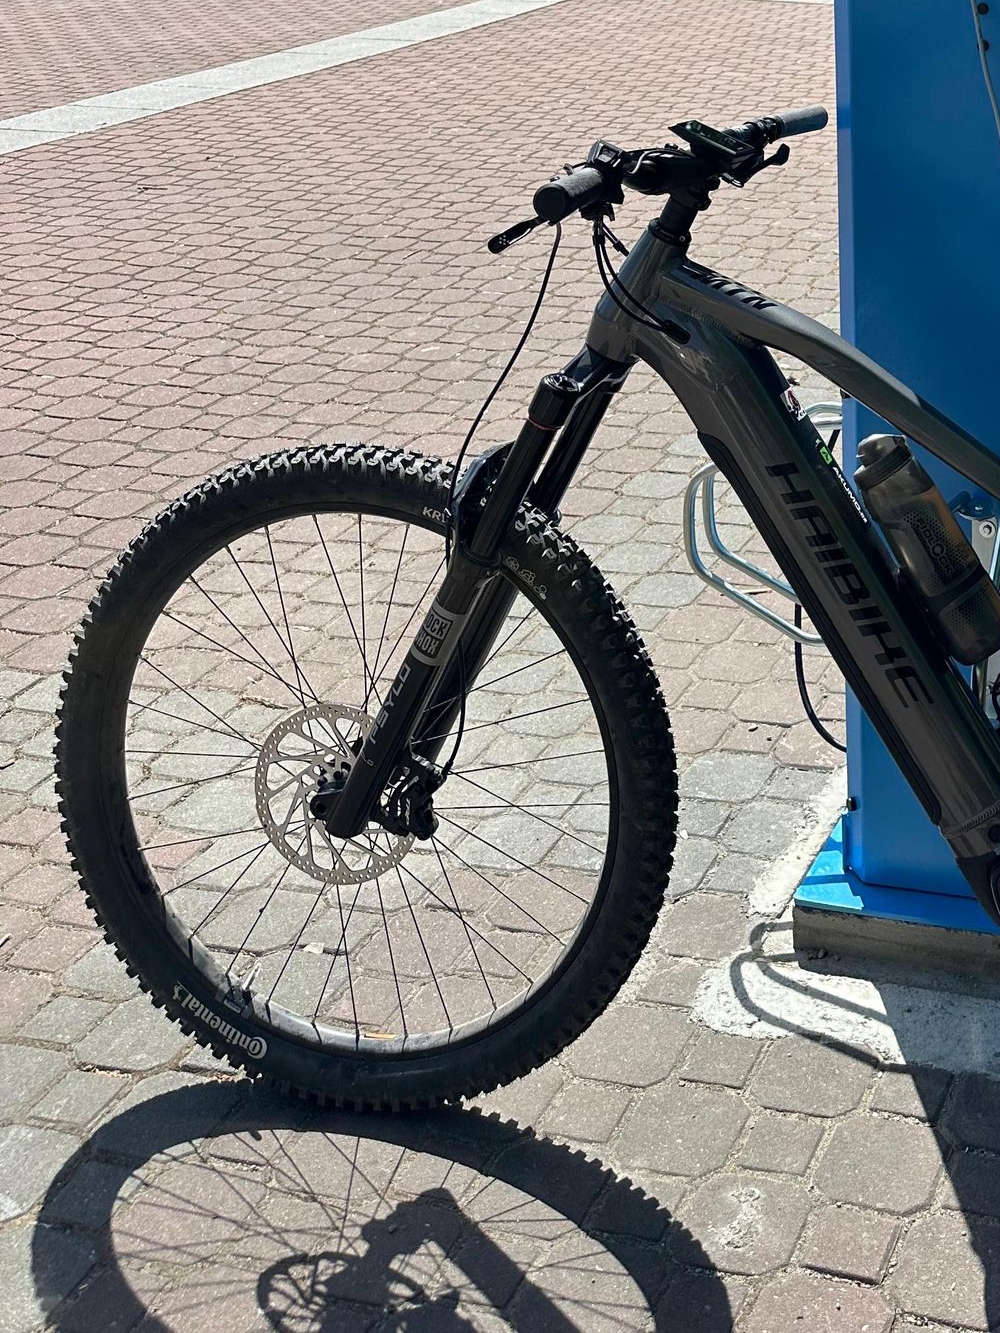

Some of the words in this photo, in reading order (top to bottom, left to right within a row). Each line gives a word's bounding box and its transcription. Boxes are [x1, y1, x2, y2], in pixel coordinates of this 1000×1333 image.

[917, 517, 956, 578] FIDLOCK
[764, 461, 935, 708] HAIBIKE
[423, 612, 449, 638] OCK
[181, 993, 268, 1060] Continental
